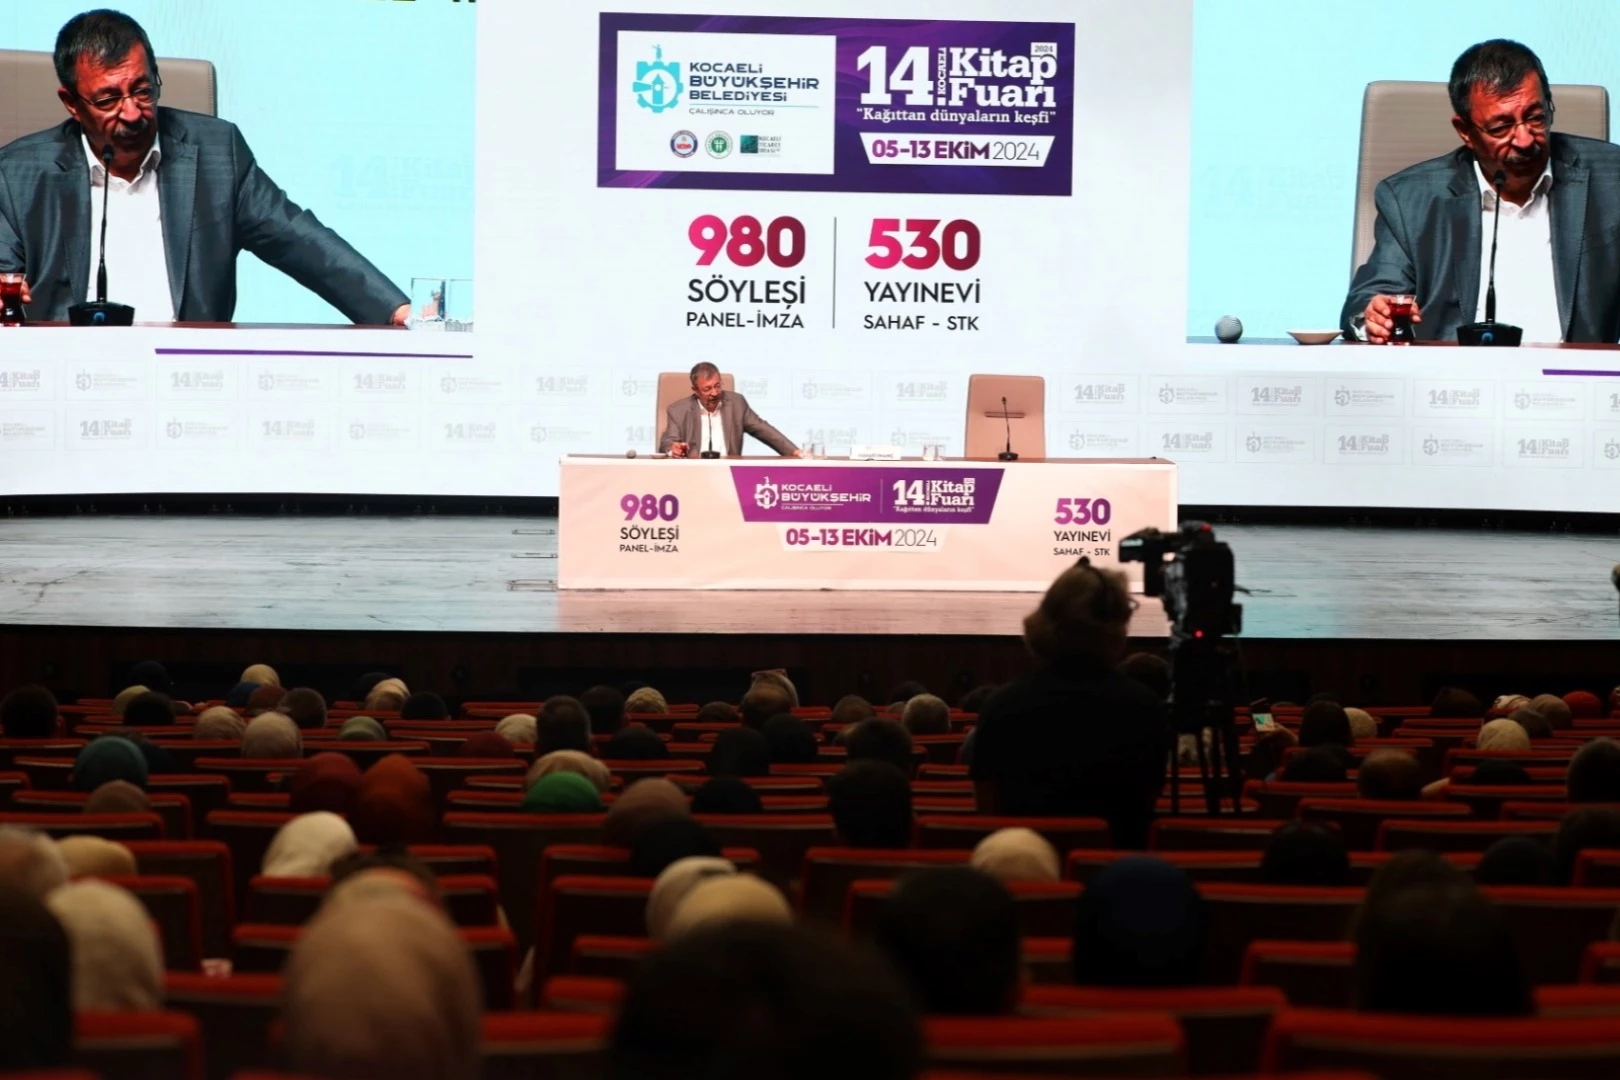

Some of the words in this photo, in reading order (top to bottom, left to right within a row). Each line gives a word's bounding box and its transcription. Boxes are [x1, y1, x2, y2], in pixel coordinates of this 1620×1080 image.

[949, 47, 1058, 85] Kitap
[948, 77, 1056, 107] Fuarı
[737, 108, 775, 116] OLUYOR
[930, 109, 1010, 124] dünyaların
[992, 141, 1040, 161] 2024
[687, 214, 806, 269] 980
[864, 218, 981, 271] 530
[687, 274, 805, 310] SÖYLEŞİ
[863, 278, 981, 304] YAYINEVİ
[686, 309, 805, 329] PANEL-İMZA
[863, 314, 926, 331] SAHAF
[946, 315, 980, 332] STK
[930, 480, 976, 496] Kitap
[620, 493, 680, 522] 980
[930, 493, 975, 506] Fuarı
[1054, 498, 1111, 526] 530
[620, 524, 680, 543] SÖYLEŞİ
[894, 529, 937, 547] 2024
[1054, 528, 1111, 543] YAYINEVİ
[619, 543, 679, 553] PANEL-İMZA
[1053, 547, 1084, 556] SAHAF
[1094, 547, 1111, 556] STK
